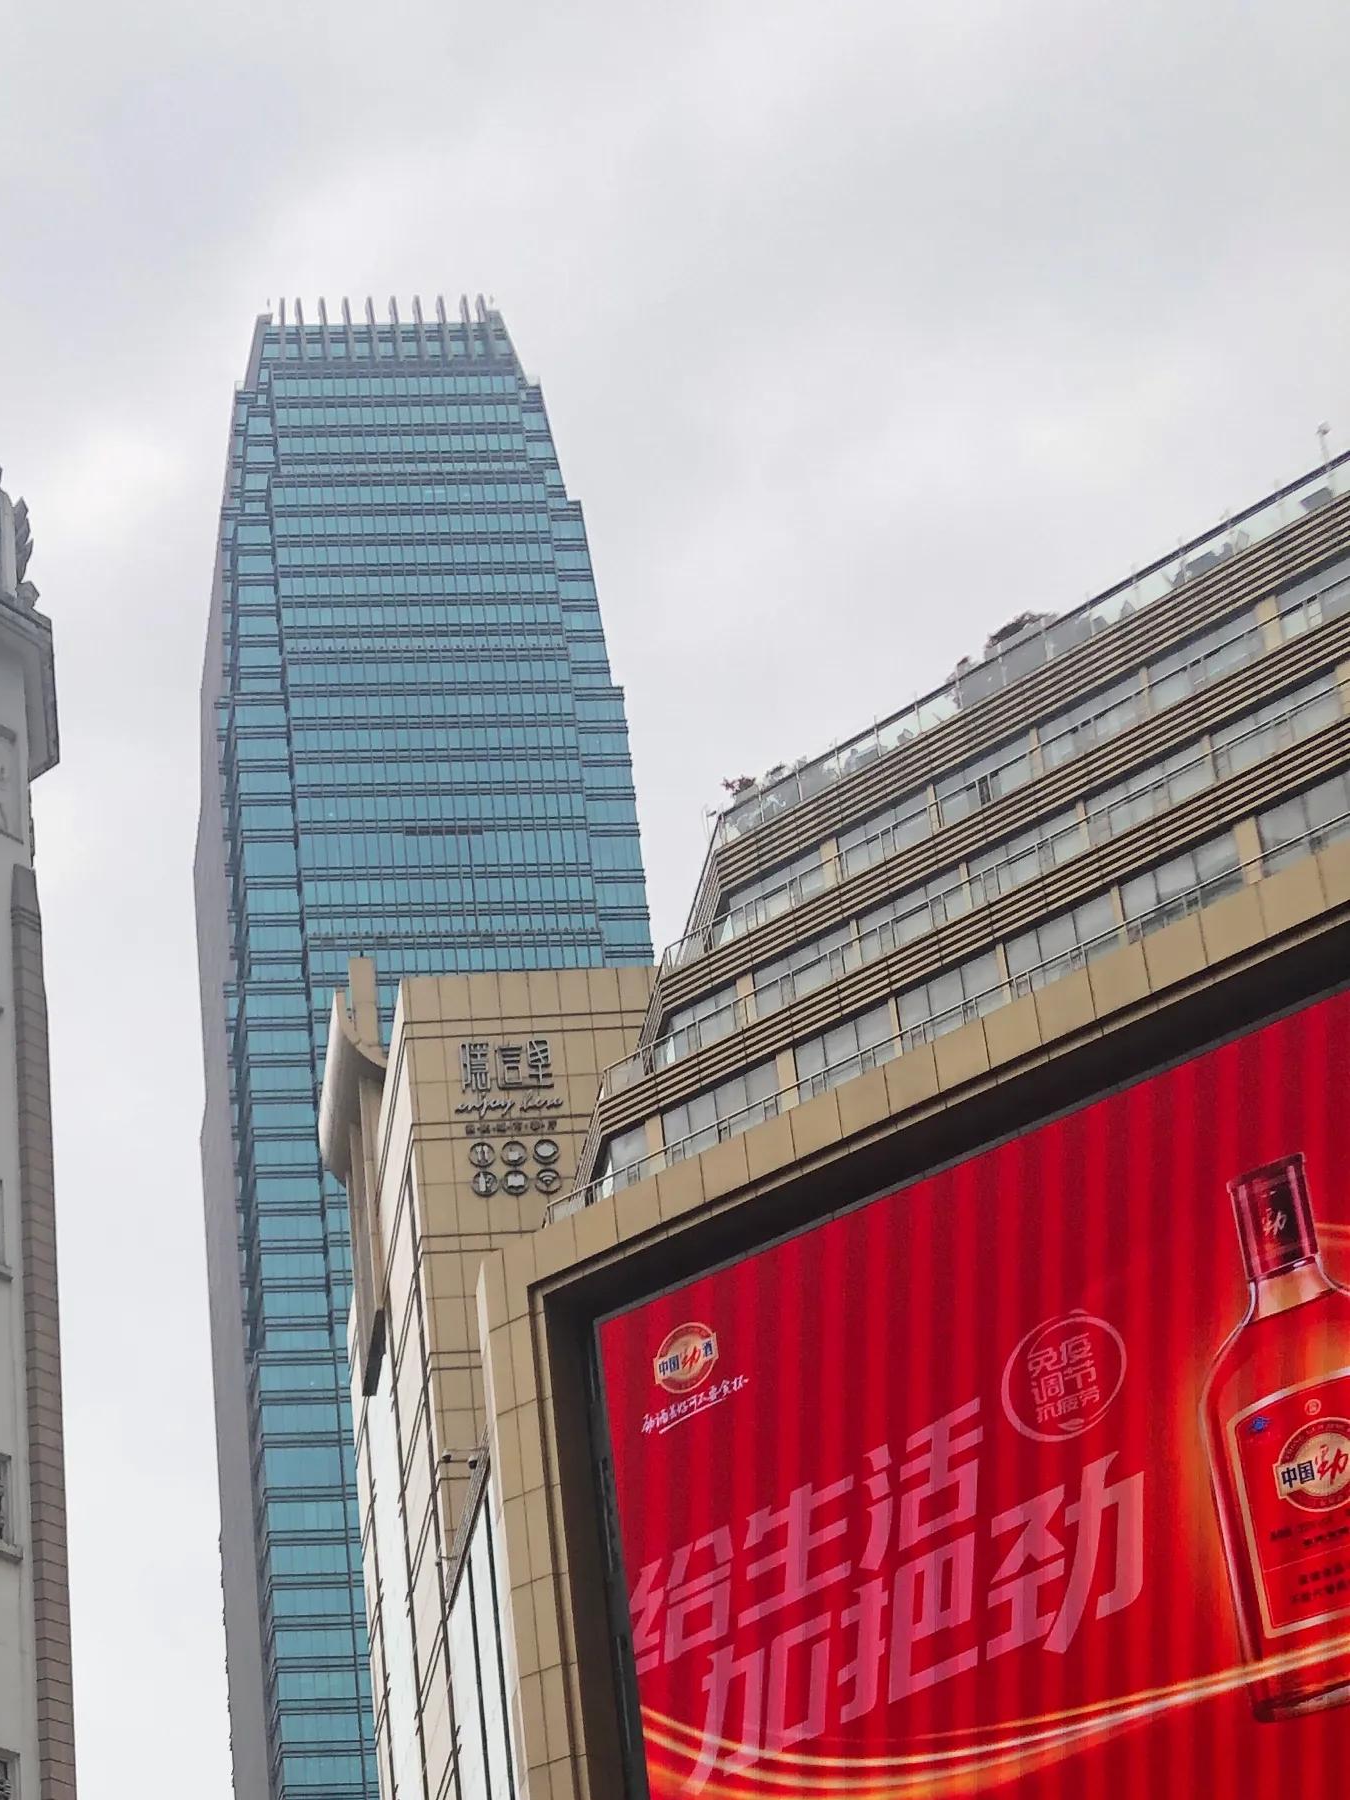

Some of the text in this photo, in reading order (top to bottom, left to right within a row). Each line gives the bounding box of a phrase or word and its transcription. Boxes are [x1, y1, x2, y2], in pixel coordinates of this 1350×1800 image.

[1030, 1360, 1098, 1405] 调节
[631, 1396, 984, 1677] 给生活
[681, 1449, 1145, 1796] 加把劲
